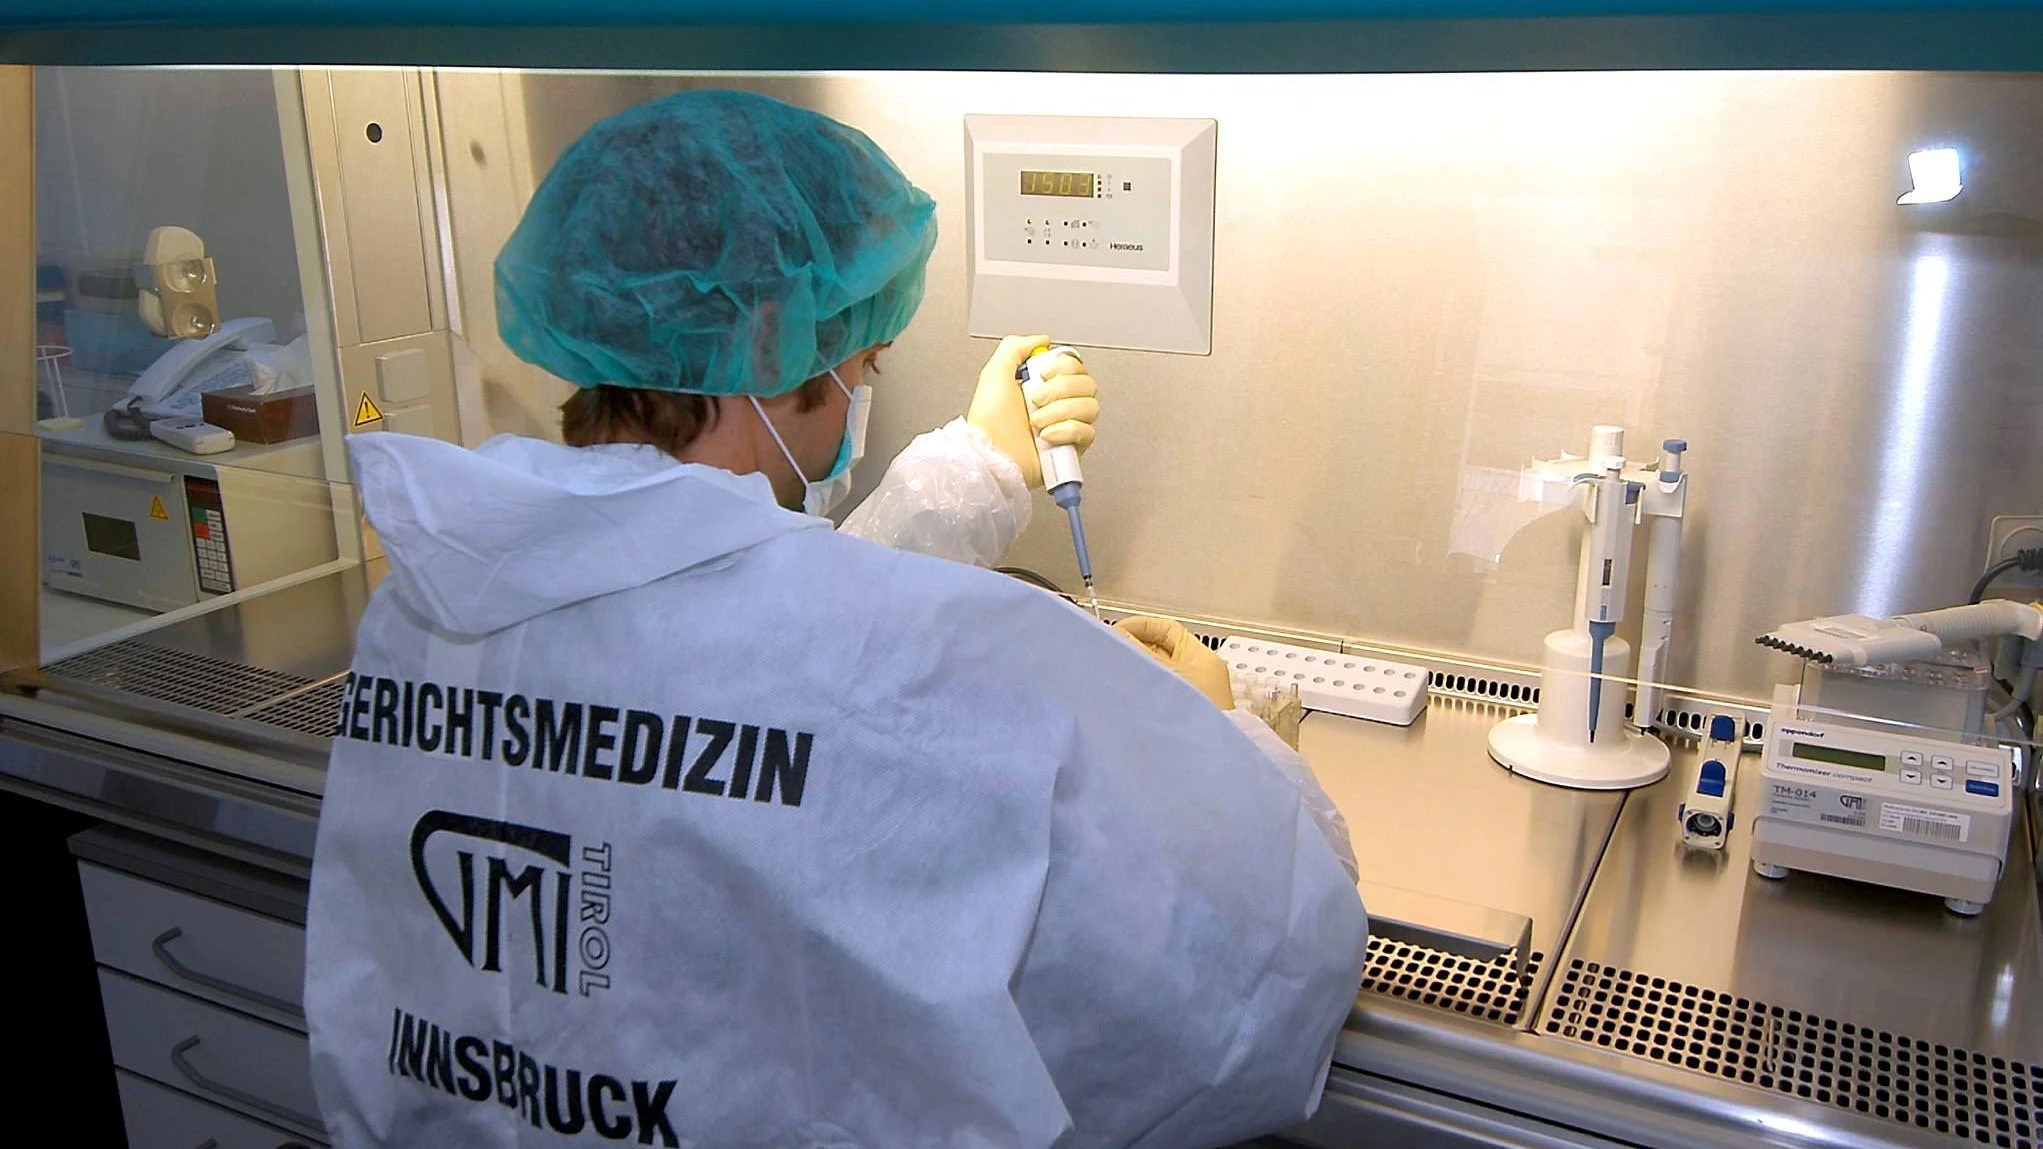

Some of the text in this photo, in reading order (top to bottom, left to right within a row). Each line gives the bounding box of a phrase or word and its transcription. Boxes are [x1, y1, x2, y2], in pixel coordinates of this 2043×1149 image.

[1110, 242, 1144, 251] Heraeus
[1781, 728, 1825, 738] eppendorf
[1773, 785, 1817, 798] TM-014
[579, 842, 611, 998] TIROL
[389, 1007, 680, 1149] INNSBRUCK
